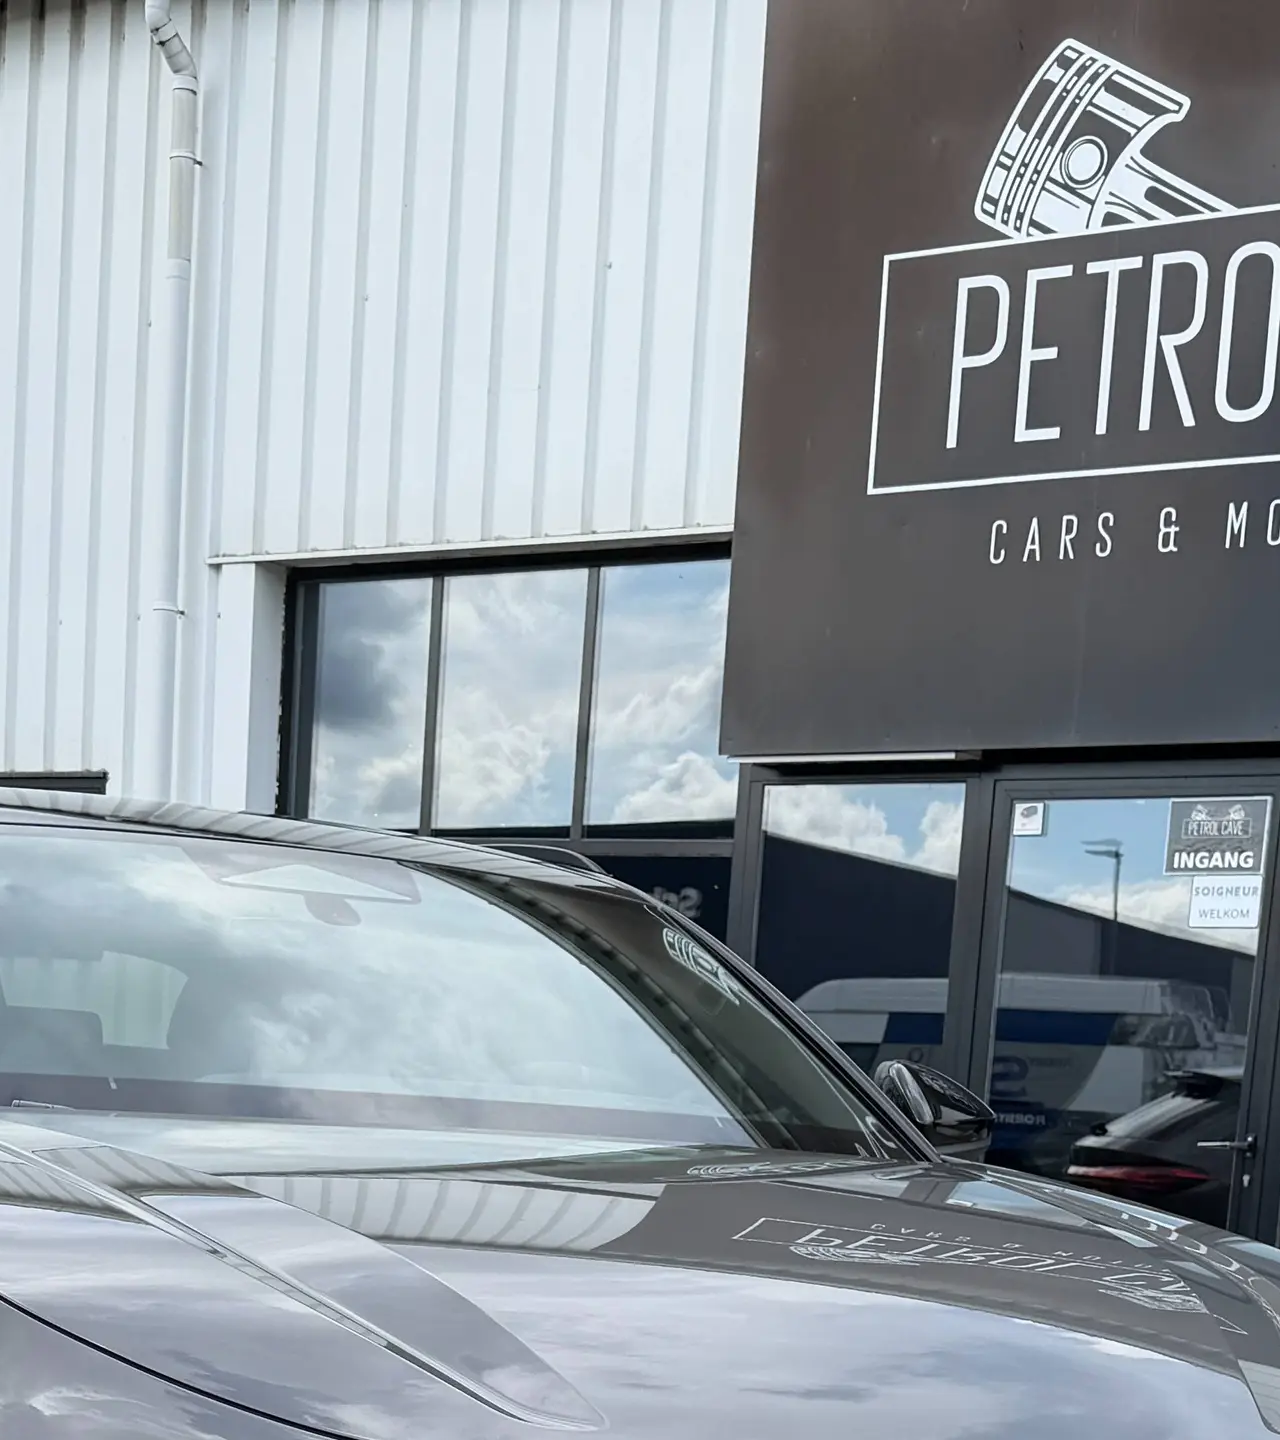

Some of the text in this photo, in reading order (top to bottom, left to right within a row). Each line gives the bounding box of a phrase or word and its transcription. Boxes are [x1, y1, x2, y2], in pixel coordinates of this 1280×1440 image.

[989, 512, 1115, 564] CARS
[1158, 506, 1180, 553] &
[1187, 820, 1245, 836] PETROL CAVE
[1173, 851, 1254, 869] INGANG
[1194, 886, 1259, 897] SOIGNEUR
[1198, 908, 1250, 919] WELKOM
